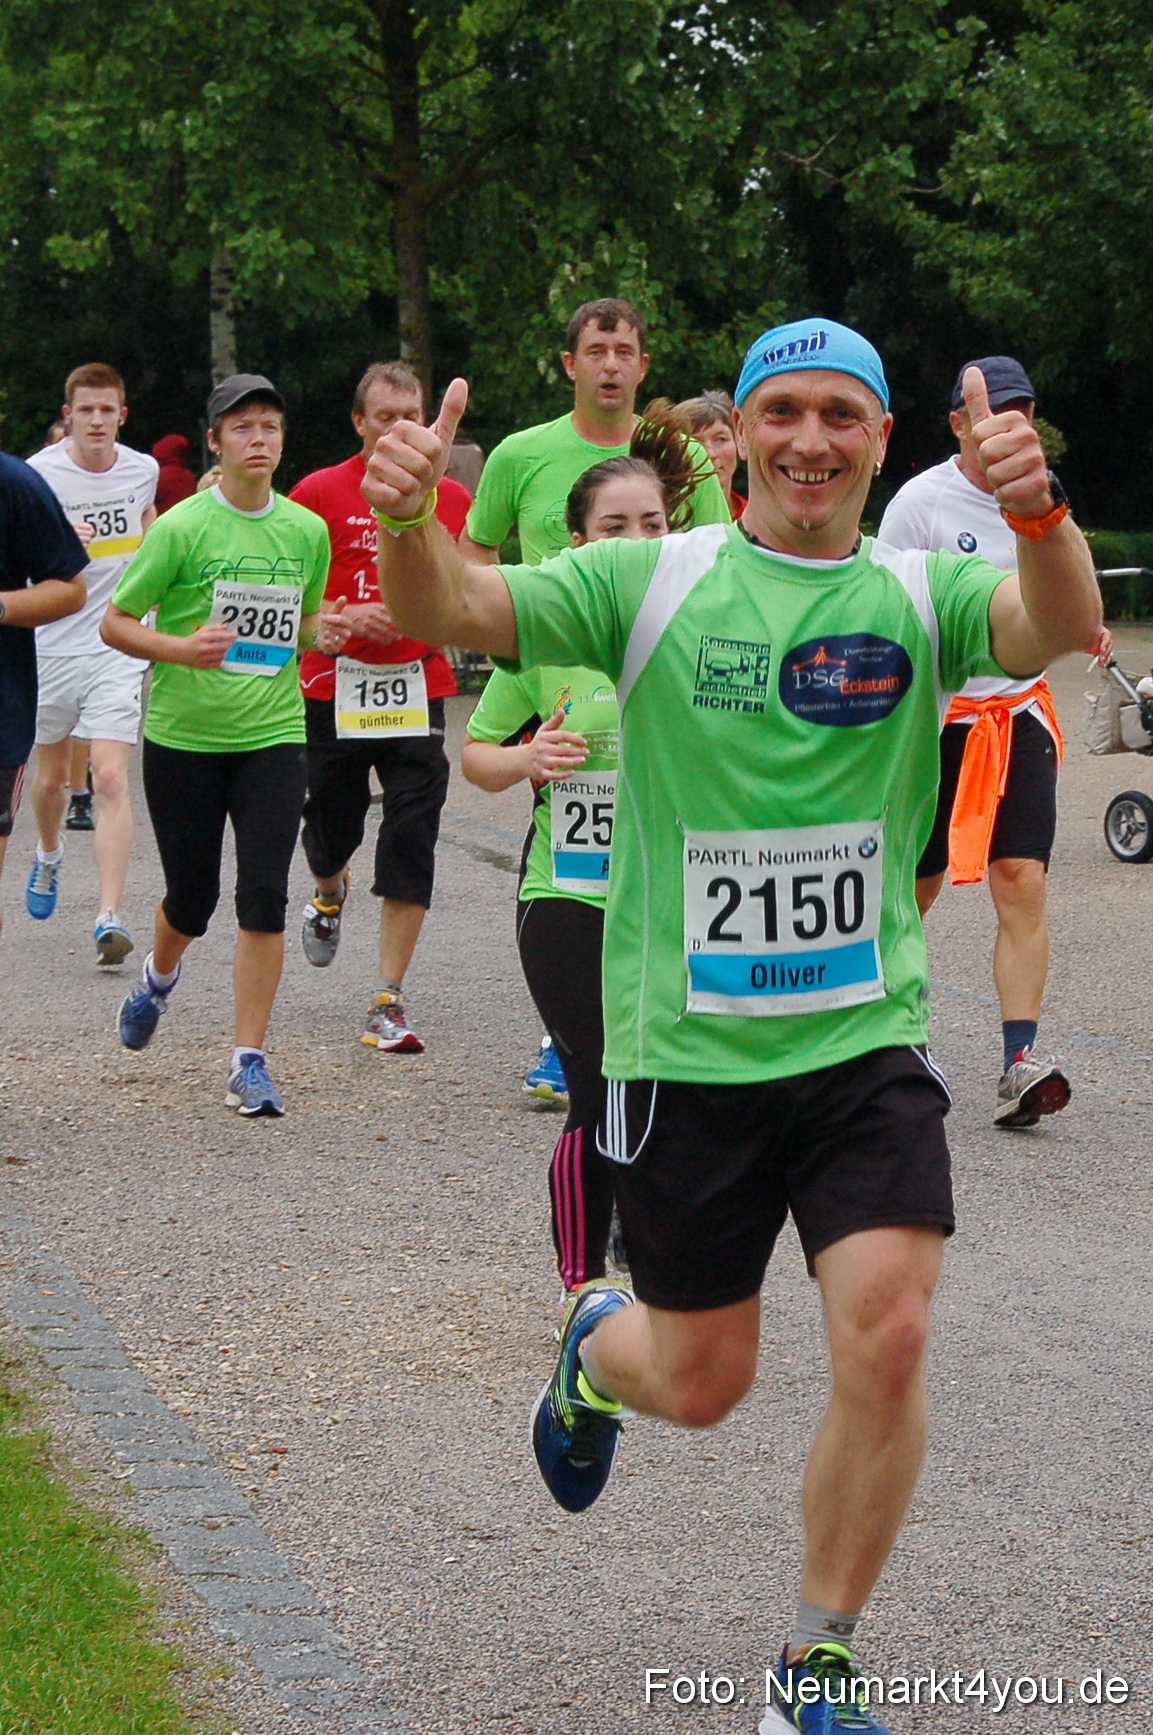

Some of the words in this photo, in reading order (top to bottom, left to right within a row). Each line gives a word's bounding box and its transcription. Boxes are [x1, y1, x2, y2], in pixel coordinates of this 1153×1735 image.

[83, 508, 128, 538] 535
[216, 590, 249, 601] PARTL
[249, 593, 291, 604] Neumarkt
[221, 605, 294, 642] 2385
[235, 646, 267, 661] Anita
[354, 678, 408, 707] 159
[840, 674, 899, 695] Eckstein
[692, 694, 765, 714] RICHTER
[359, 714, 404, 729] günther
[552, 782, 594, 795] PARTL
[564, 801, 614, 847] 25
[687, 849, 753, 867] PARTL
[758, 843, 850, 866] Neumarkt
[706, 869, 865, 943] 2150
[750, 962, 827, 989] Oliver
